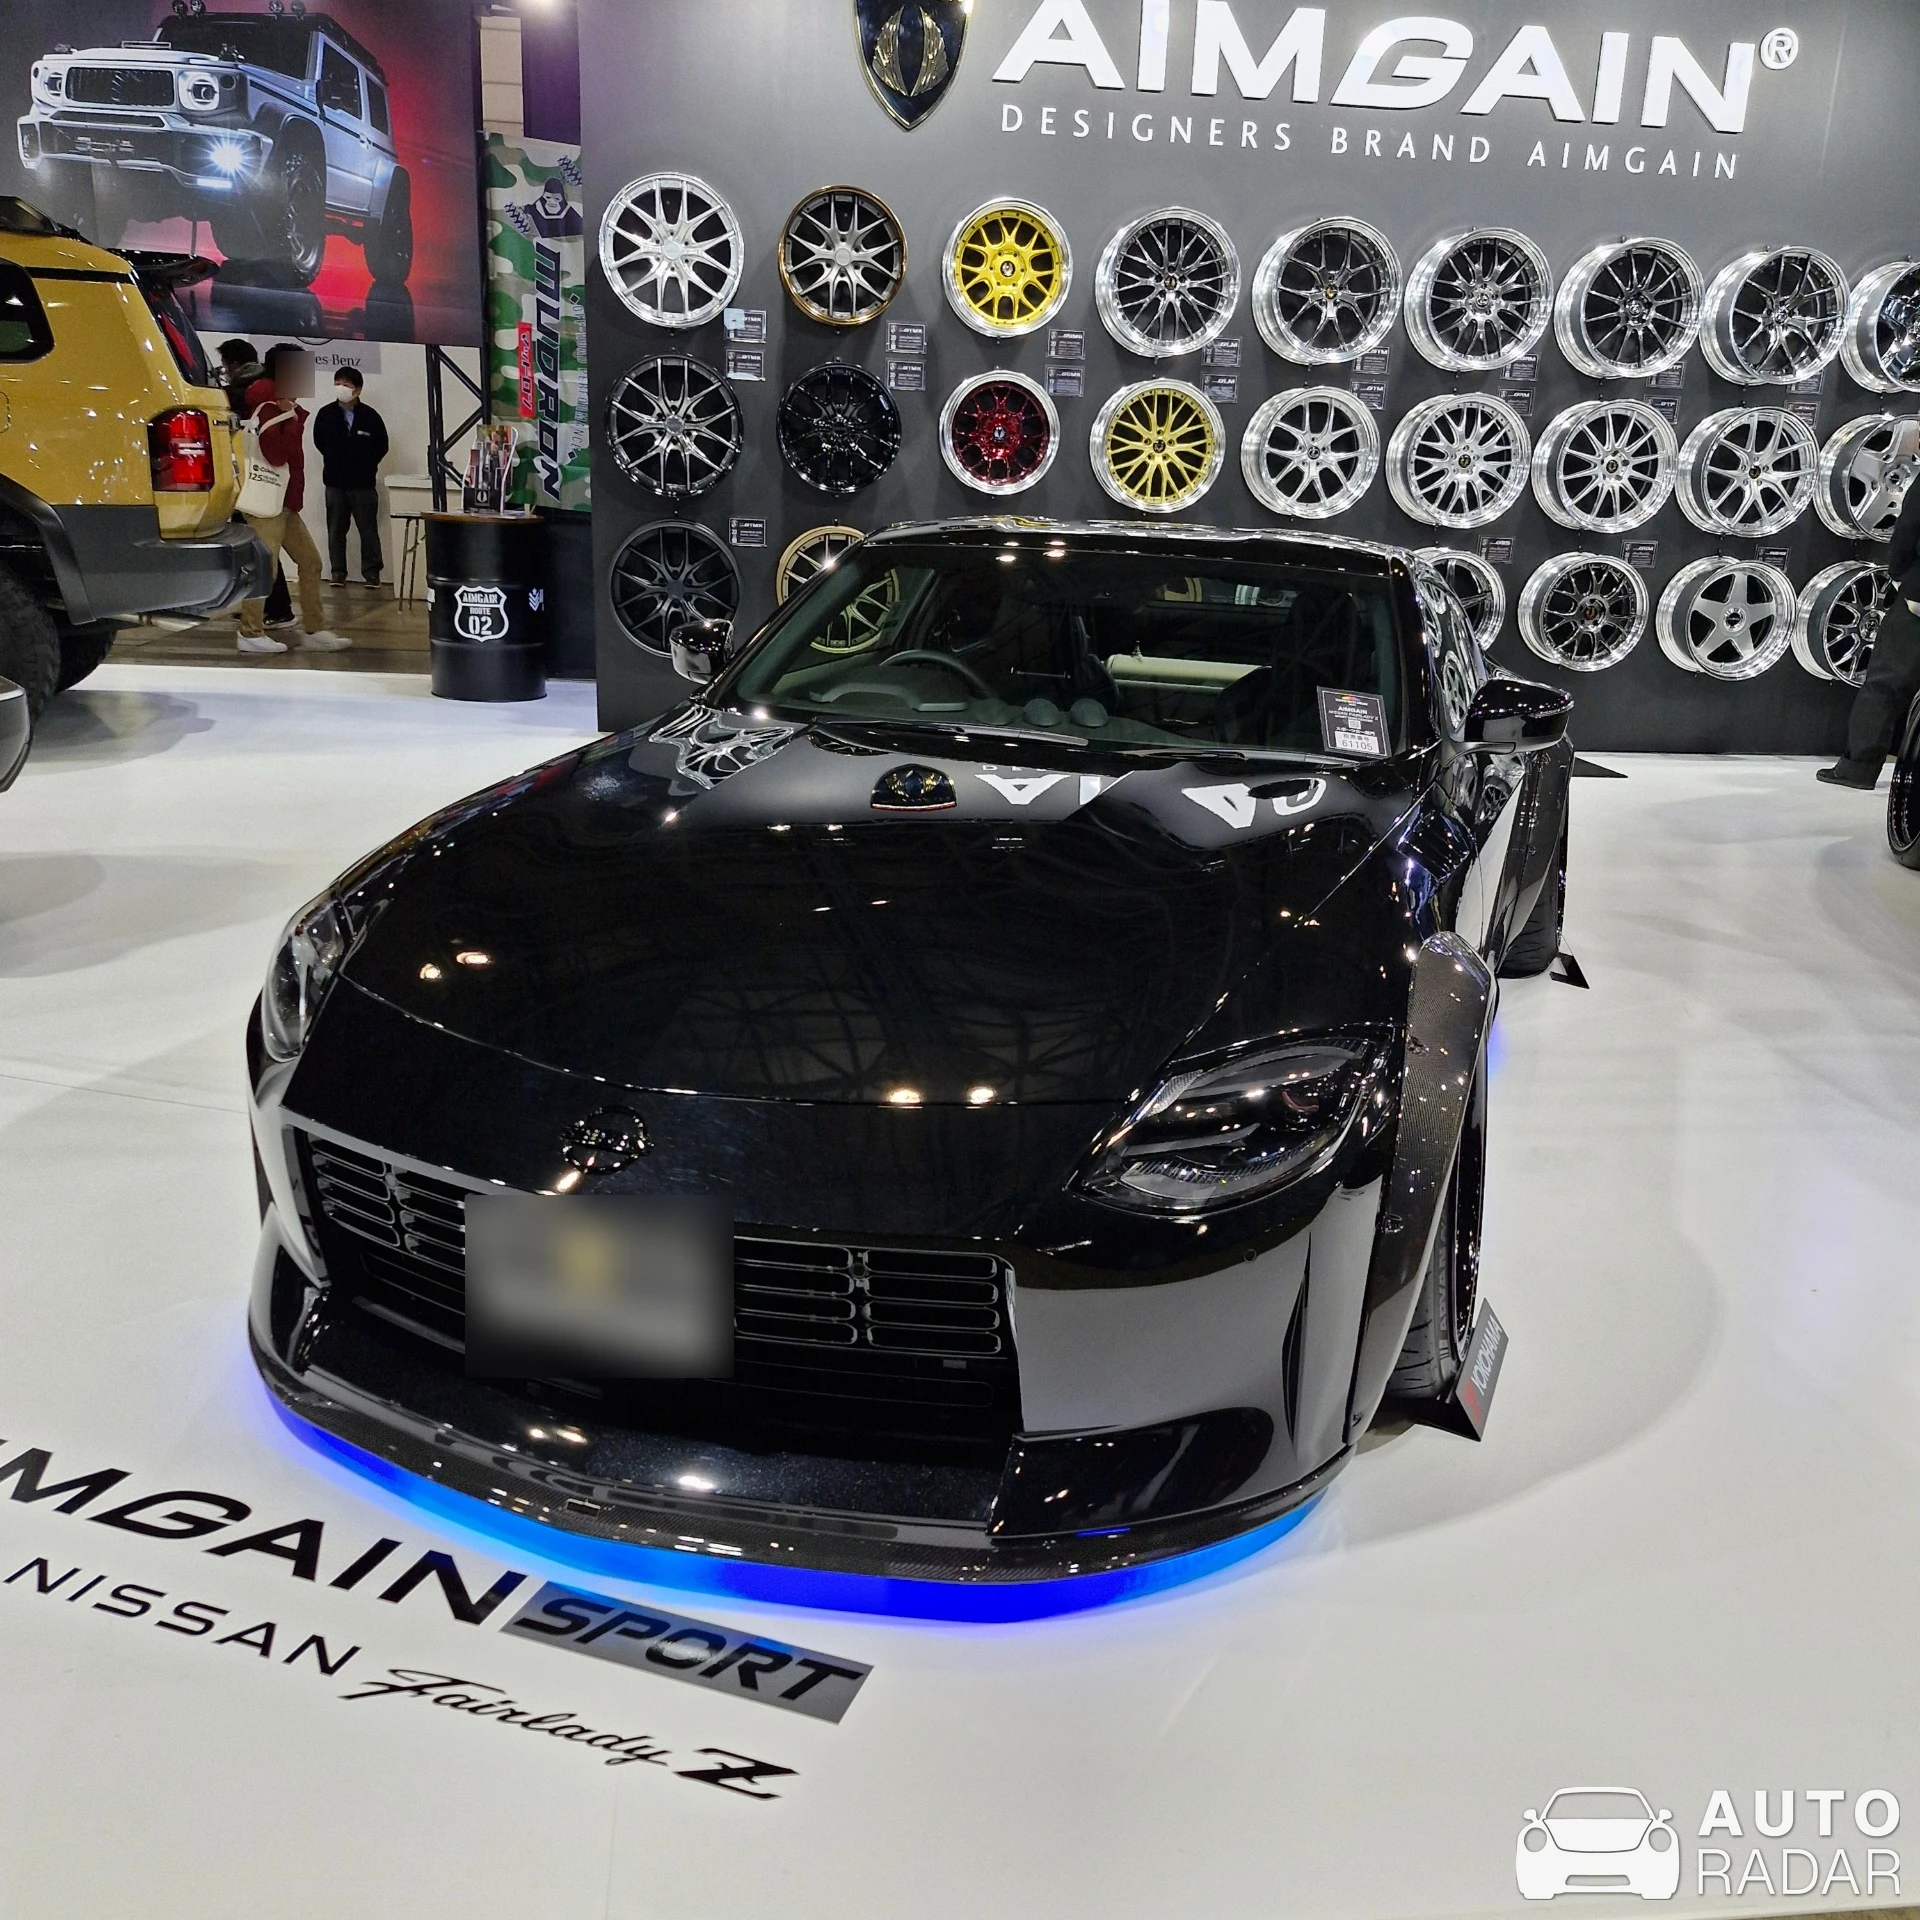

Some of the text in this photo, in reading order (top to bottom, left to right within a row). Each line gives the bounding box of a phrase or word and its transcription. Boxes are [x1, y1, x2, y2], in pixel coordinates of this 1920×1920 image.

[1002, 104, 1737, 180] DESIGNERS BRAND AIMGAIN
[535, 241, 561, 502] MUDRON
[248, 472, 263, 482] 125
[462, 592, 498, 604] AIMGAIN
[469, 607, 492, 615] ROUTE
[468, 615, 493, 635] 02
[1342, 740, 1373, 751] 61105
[1470, 1314, 1503, 1396] YOKOHAMA
[0, 1438, 866, 1702] MGAIN SPORT
[3, 1557, 801, 1800] NISSAN Fairlady Z
